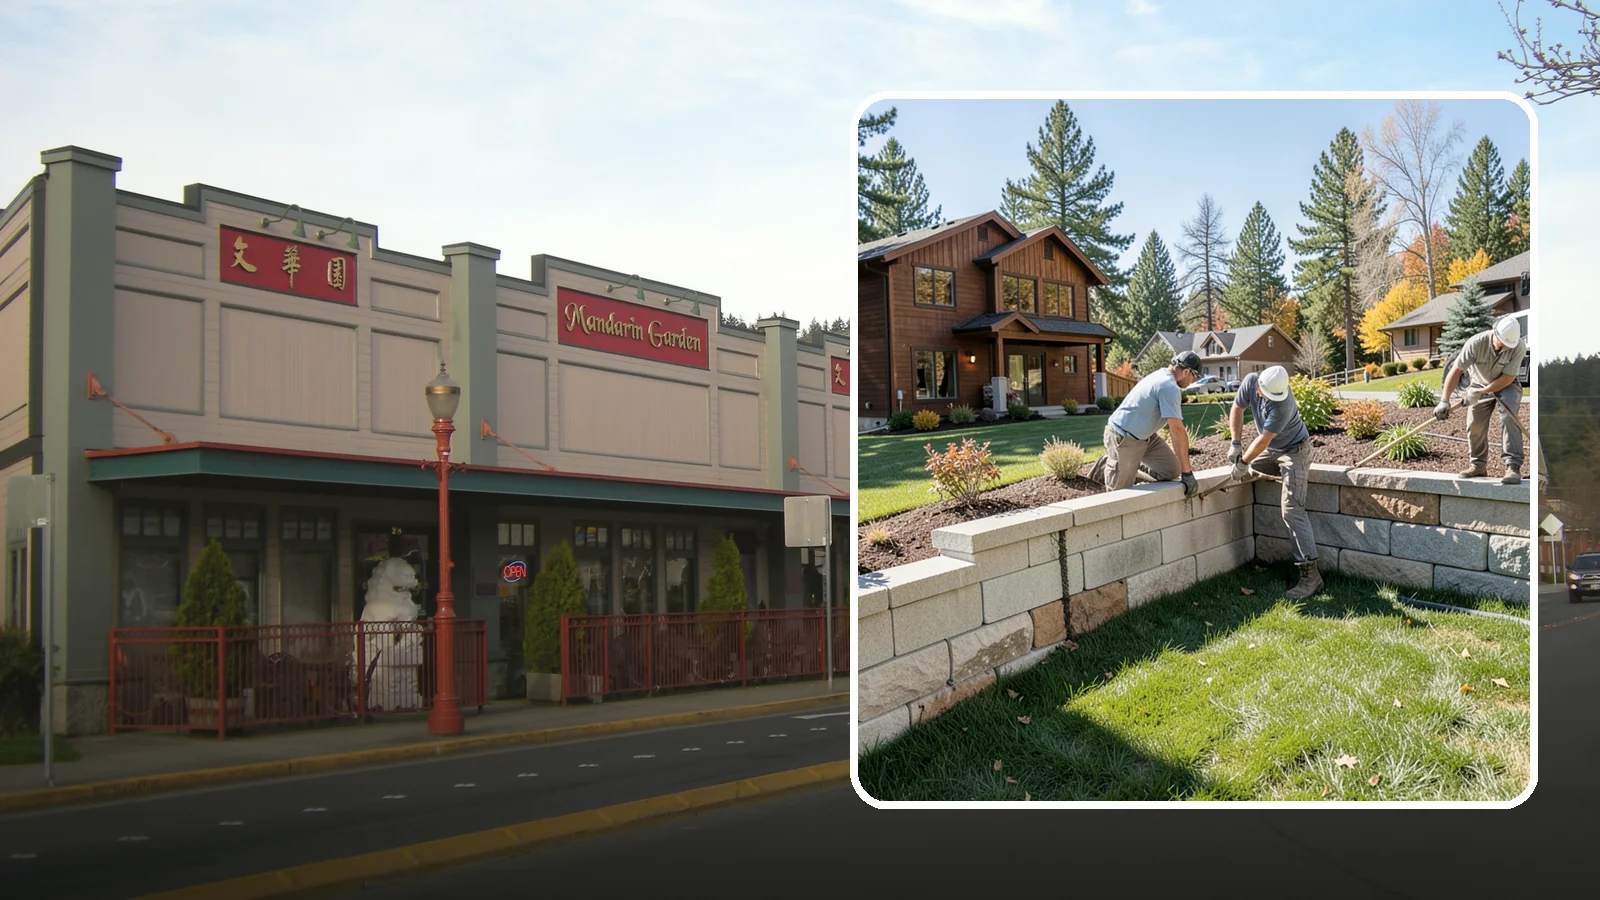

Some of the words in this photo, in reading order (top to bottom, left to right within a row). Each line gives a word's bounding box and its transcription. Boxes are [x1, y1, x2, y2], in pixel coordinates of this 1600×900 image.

[231, 236, 346, 291] 文華園
[564, 303, 644, 341] Mandarin
[648, 321, 701, 352] Garden
[835, 363, 846, 386] 文
[503, 565, 527, 578] OPEN
